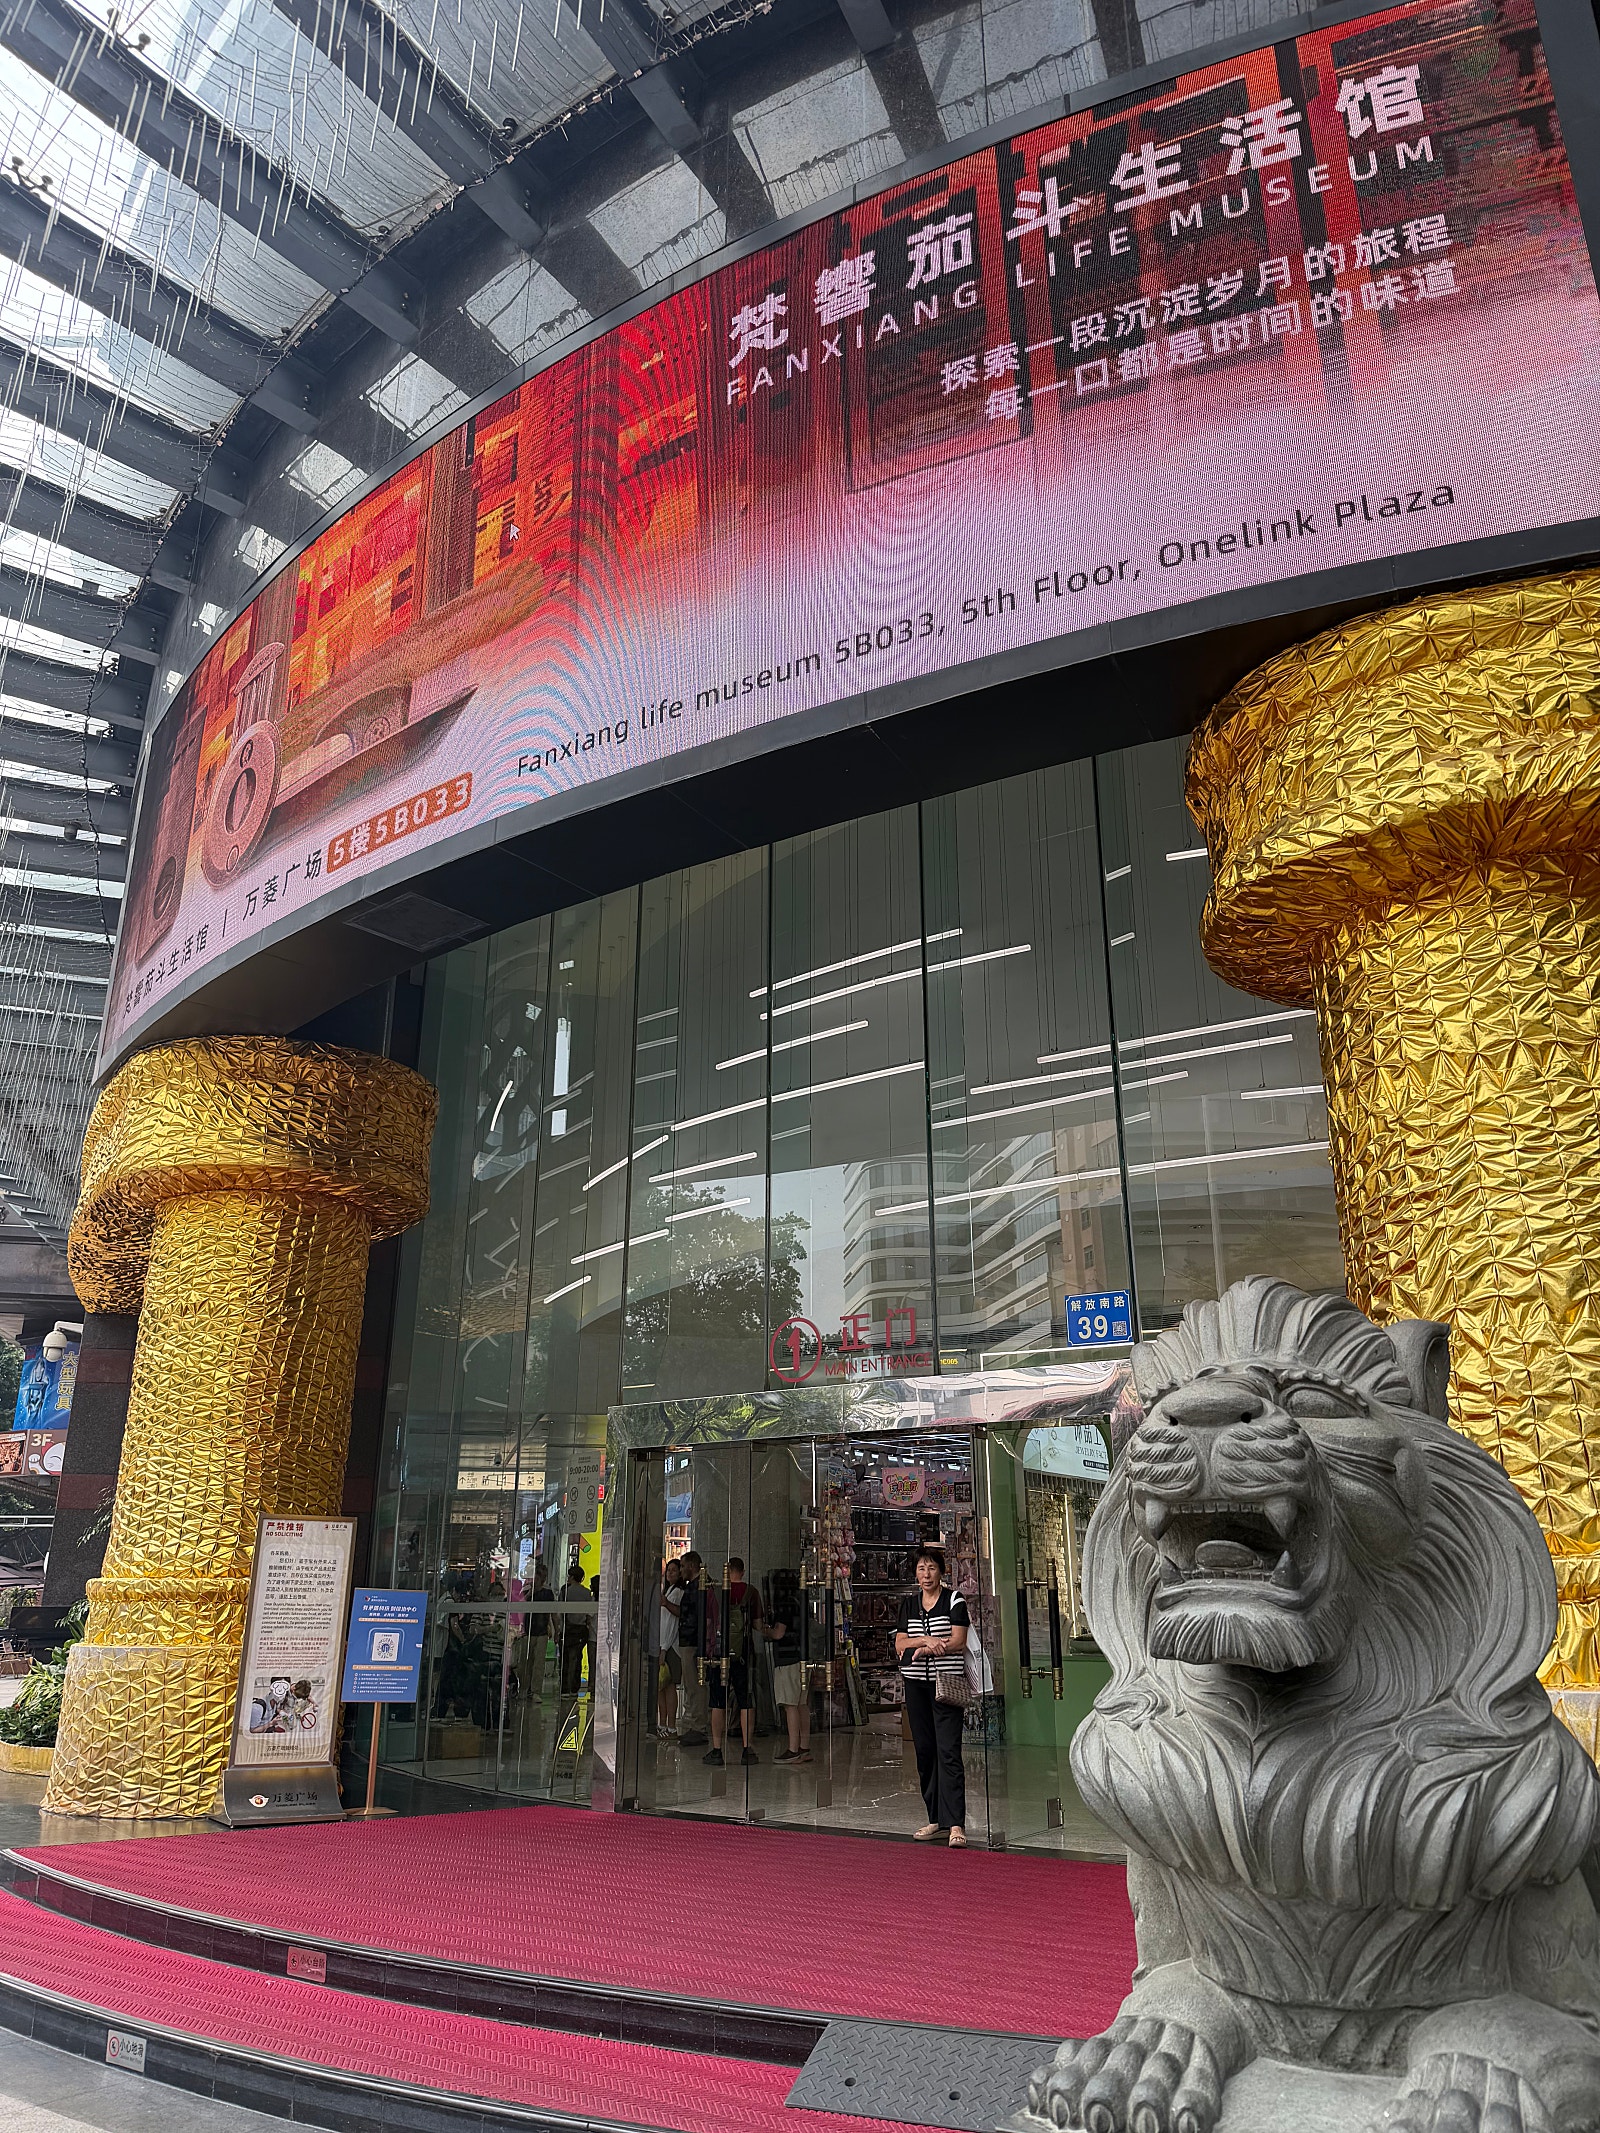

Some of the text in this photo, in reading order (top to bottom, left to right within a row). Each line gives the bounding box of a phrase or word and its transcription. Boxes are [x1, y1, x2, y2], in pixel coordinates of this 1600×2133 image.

[726, 134, 1435, 405] FANXIANG LIFE MUSEUM
[940, 213, 1453, 396] 探索一段沉淀岁月的旅程
[985, 259, 1460, 422] 每一口都是时间的味道
[516, 483, 1456, 777] Fanxiang life museum 5B033, 5th Floor, Onelink Plaza
[242, 848, 323, 922] 万菱广场
[332, 778, 469, 865] 5楼5B033
[1070, 1295, 1126, 1312] 解放南路
[838, 1307, 916, 1351] 正门
[1077, 1314, 1108, 1340] 39
[823, 1351, 932, 1377] MAIN ENTRANCE
[55, 1350, 79, 1410] 大型玩具
[31, 1433, 53, 1447] 3F
[266, 1521, 304, 1531] 严禁推销
[272, 1791, 318, 1803] 万菱广场
[300, 1954, 326, 1969] 小心台阶
[119, 2037, 144, 2058] 小心地滑
